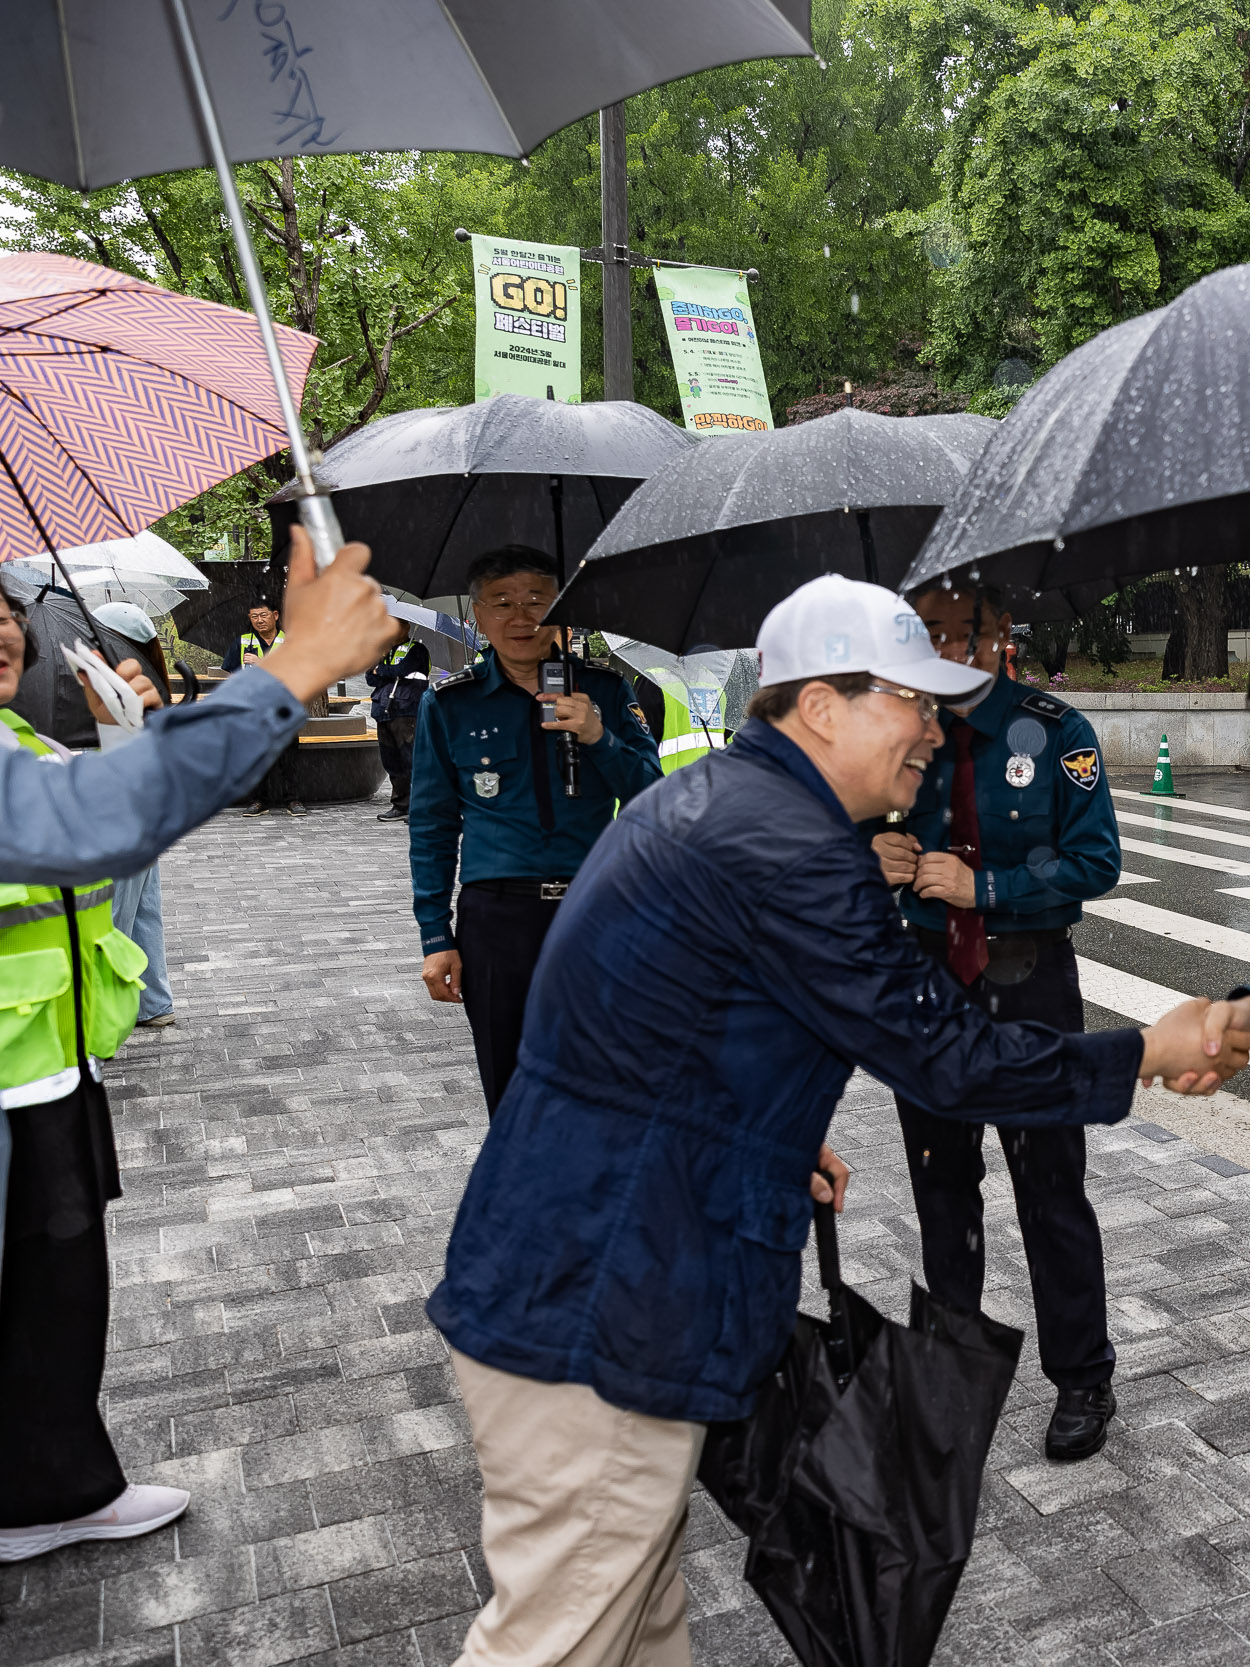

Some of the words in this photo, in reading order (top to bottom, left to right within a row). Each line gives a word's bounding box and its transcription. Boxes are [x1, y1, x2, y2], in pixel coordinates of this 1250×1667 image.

[493, 248, 508, 256] 5월
[511, 250, 535, 259] 한달간
[538, 253, 561, 264] 즐기는
[492, 257, 564, 275] 서울어린이대공원
[490, 273, 567, 320] GO!
[494, 312, 566, 343] 페스티벌
[675, 317, 739, 336] 즐기GO!
[494, 350, 551, 366] 서울어린이대공원
